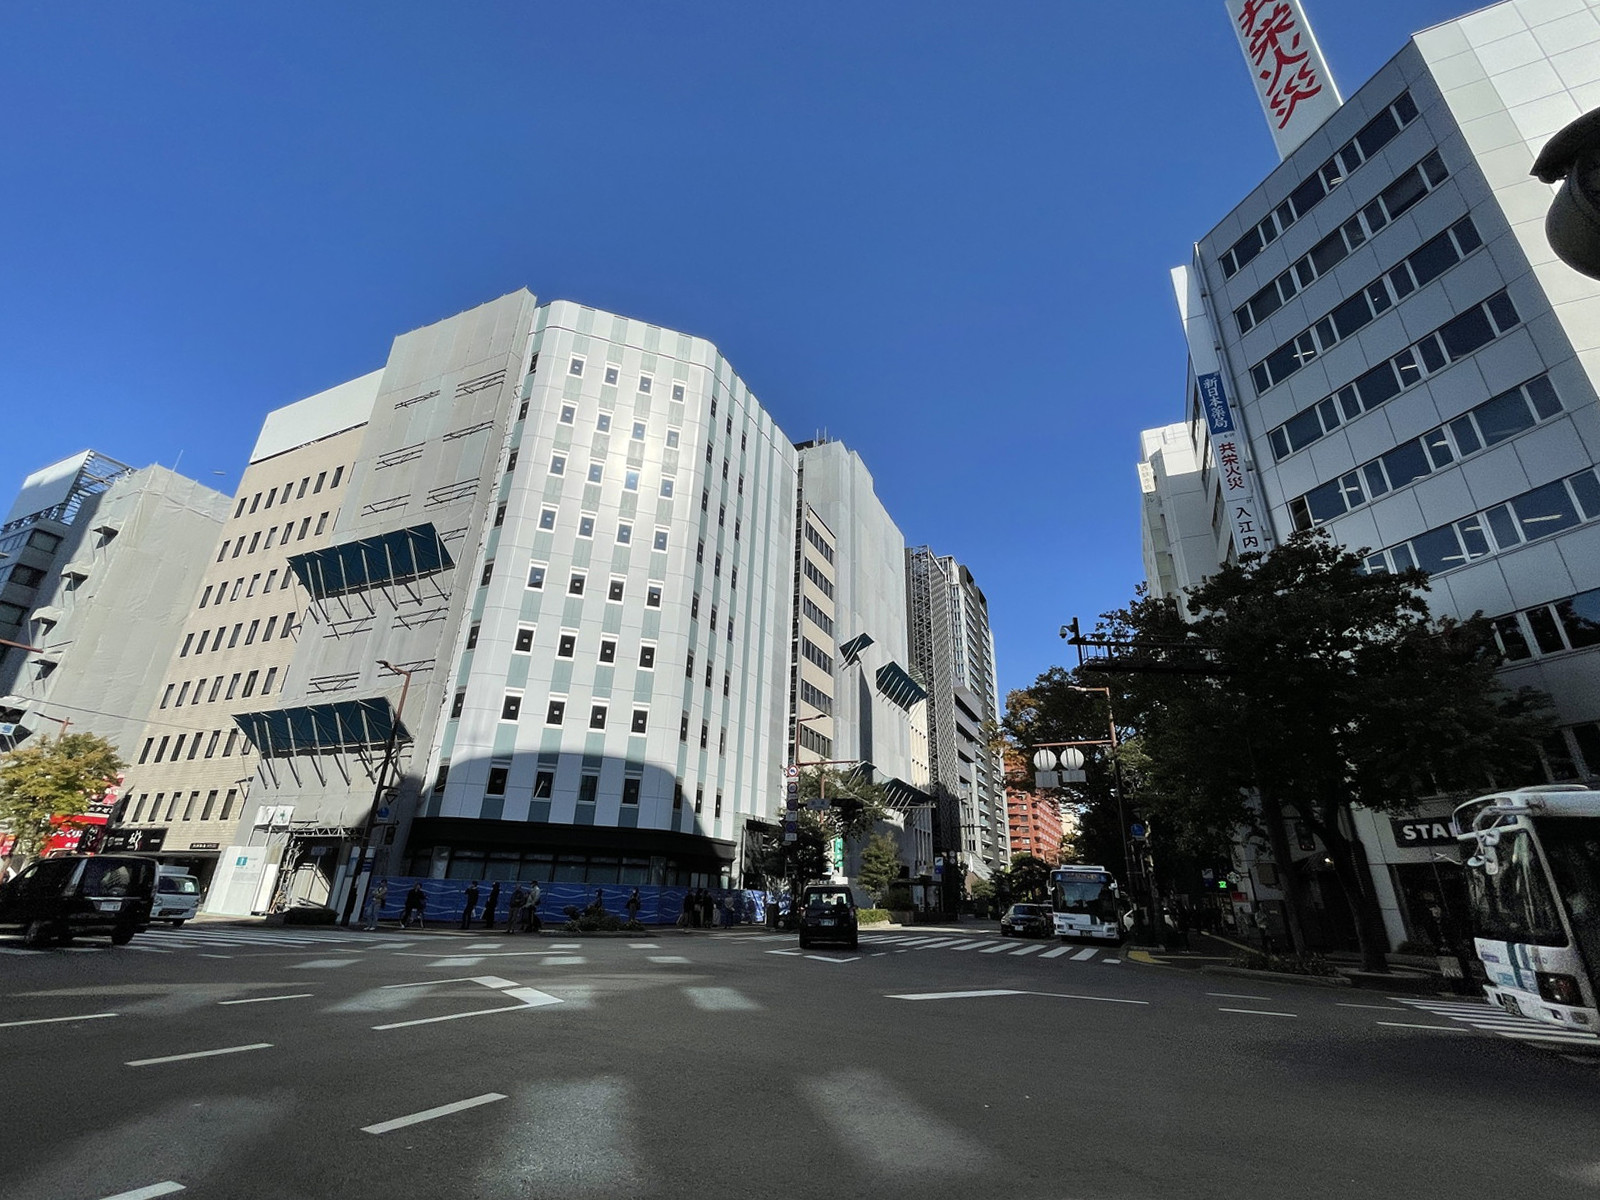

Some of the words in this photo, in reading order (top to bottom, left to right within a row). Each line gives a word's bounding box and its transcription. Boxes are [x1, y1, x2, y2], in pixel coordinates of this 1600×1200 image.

[1203, 376, 1228, 429] 新日本薬局
[1219, 442, 1246, 491] 共栄火災
